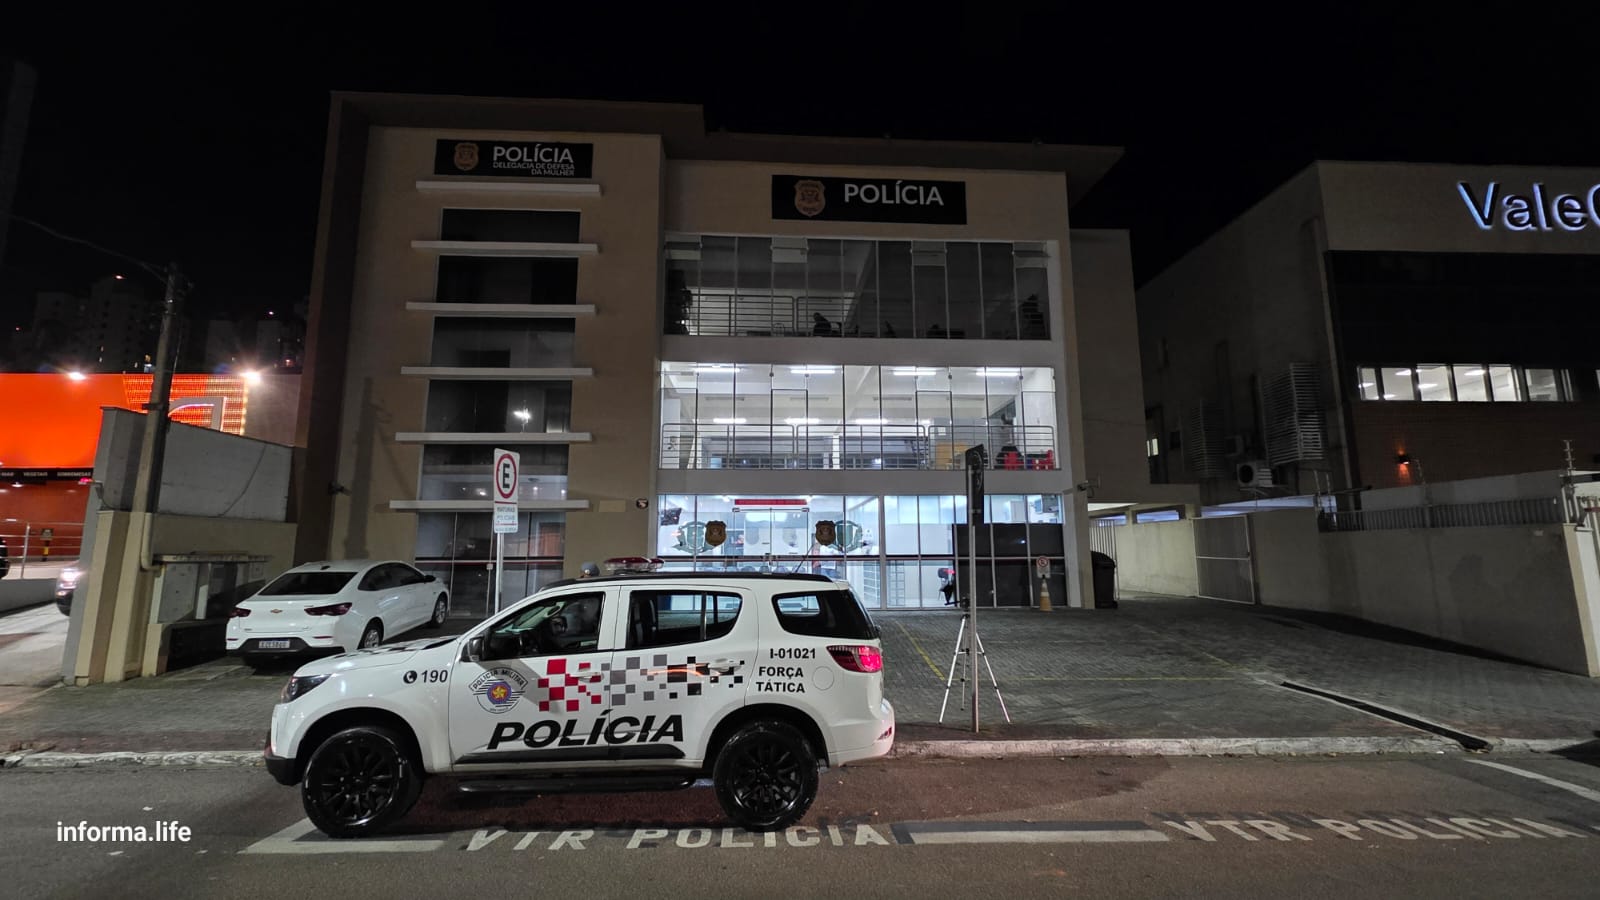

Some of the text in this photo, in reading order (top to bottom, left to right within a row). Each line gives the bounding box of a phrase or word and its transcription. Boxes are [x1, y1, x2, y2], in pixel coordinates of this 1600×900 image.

[493, 144, 574, 163] POLÍCIA
[844, 180, 944, 206] POLÍCIA
[502, 463, 511, 489] E
[770, 648, 816, 659] I-01021
[421, 669, 448, 683] 190
[758, 666, 804, 680] FORÇA
[755, 679, 806, 693] TÁTICA
[486, 709, 684, 750] POLÍCIA
[465, 824, 890, 852] VTR POLICIA
[1163, 819, 1313, 842] VTR
